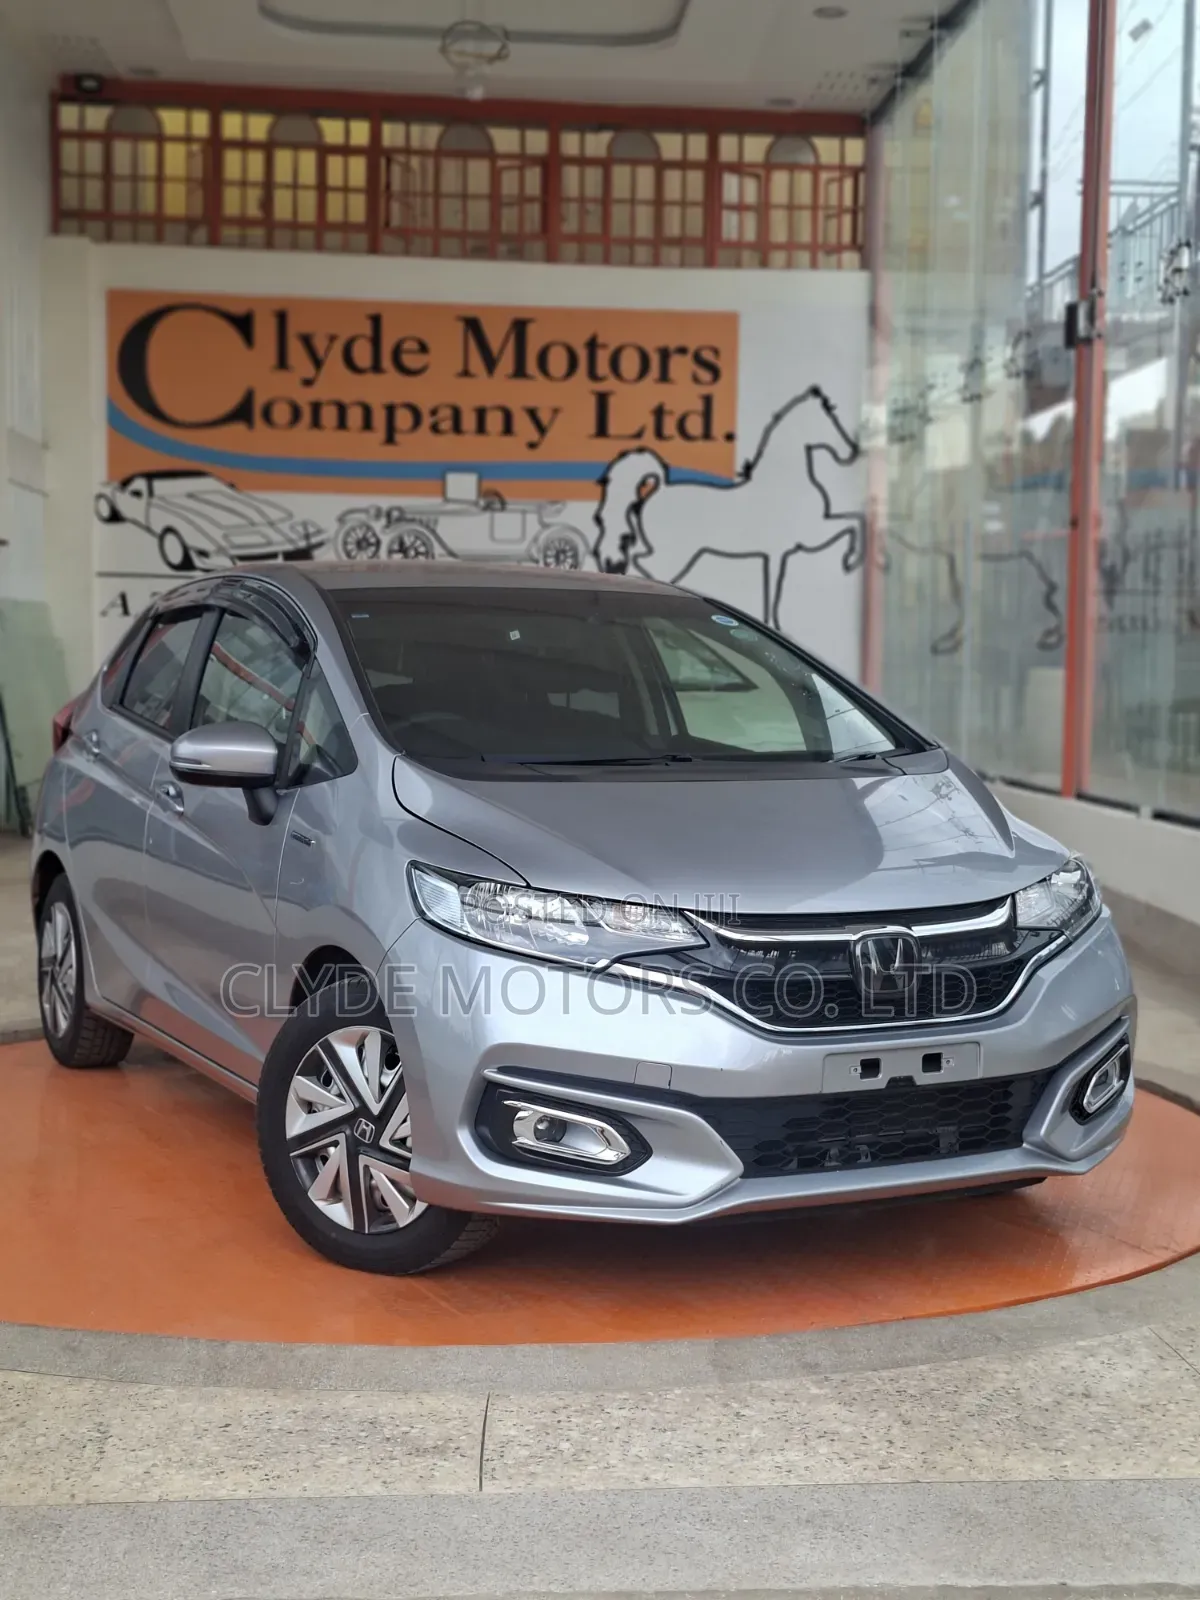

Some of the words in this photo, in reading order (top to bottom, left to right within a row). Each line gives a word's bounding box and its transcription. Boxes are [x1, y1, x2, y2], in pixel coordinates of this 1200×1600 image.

[115, 301, 431, 430] Clyde
[457, 315, 721, 385] Motors
[588, 391, 736, 443] Ltd.
